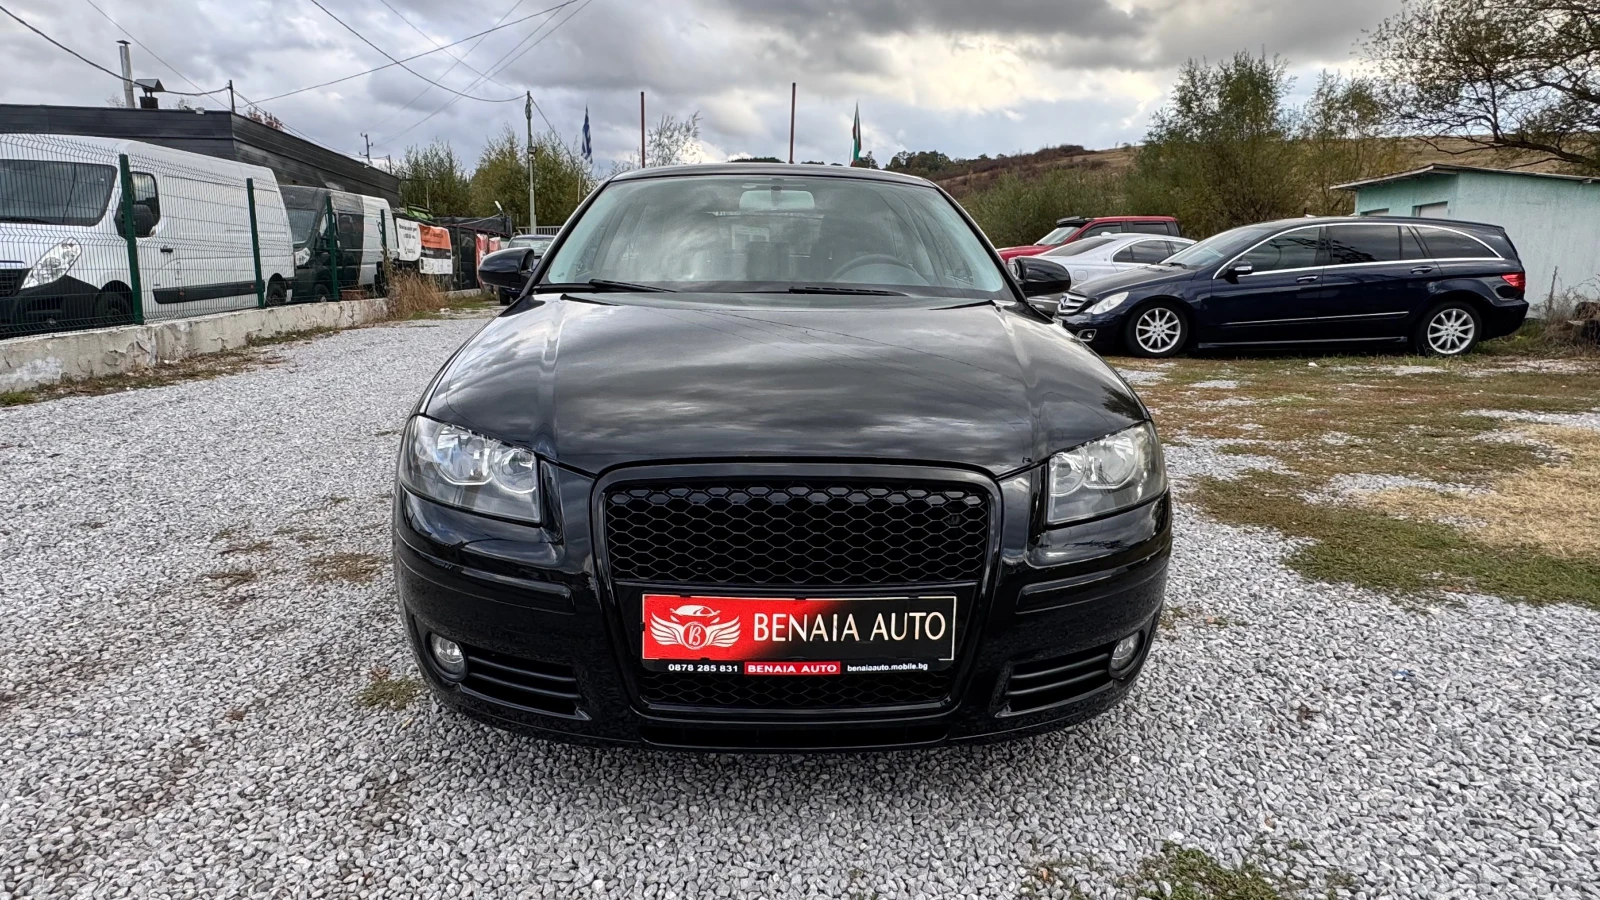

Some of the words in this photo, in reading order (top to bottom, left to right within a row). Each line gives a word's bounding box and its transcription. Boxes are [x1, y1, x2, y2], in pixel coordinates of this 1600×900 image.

[753, 612, 860, 642] BENAIA
[869, 611, 946, 642] AUTO
[668, 663, 694, 672] 0878
[696, 663, 717, 672] 285
[719, 663, 738, 672] 831
[747, 664, 797, 673] BENAIA
[800, 664, 837, 673] AUTO
[846, 662, 929, 673] benaiaauto.mobile.bg
